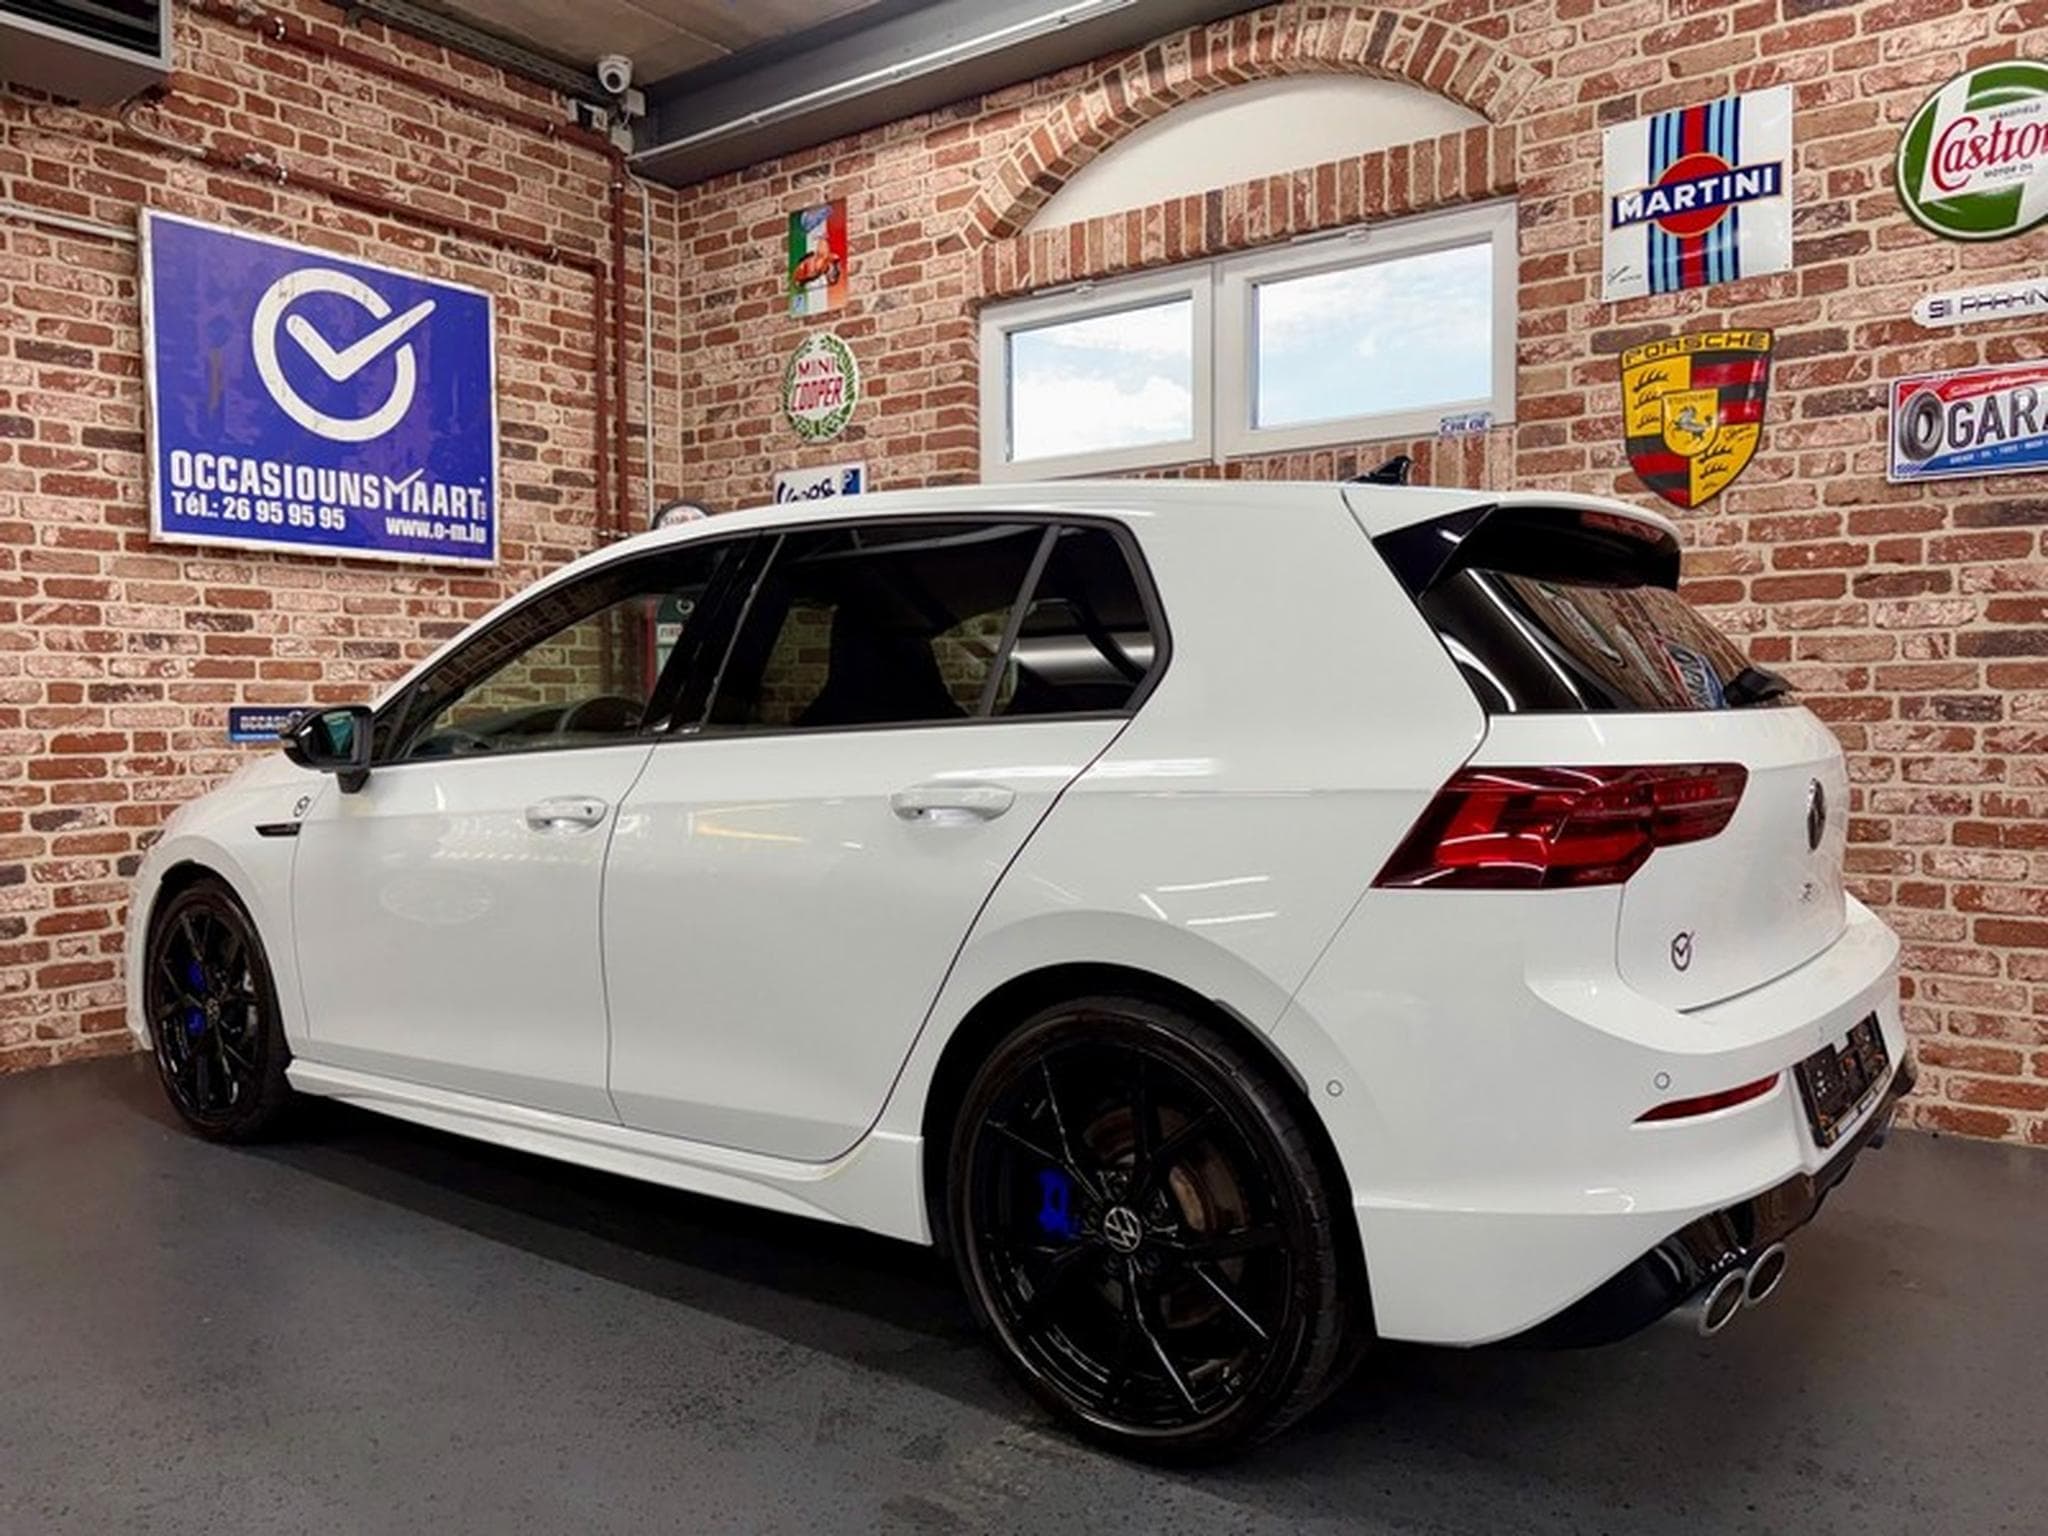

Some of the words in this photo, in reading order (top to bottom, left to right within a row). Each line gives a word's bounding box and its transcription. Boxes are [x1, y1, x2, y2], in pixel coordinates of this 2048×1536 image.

[1617, 166, 1773, 224] MARTINI
[796, 355, 836, 379] MINI
[1625, 333, 1765, 365] PORSCHE
[791, 376, 843, 413] COOPER
[170, 449, 483, 520] OCCASIOUNSMAART
[222, 496, 250, 521] 26
[255, 499, 284, 524] 95
[288, 502, 316, 528] 95
[319, 505, 346, 531] 95
